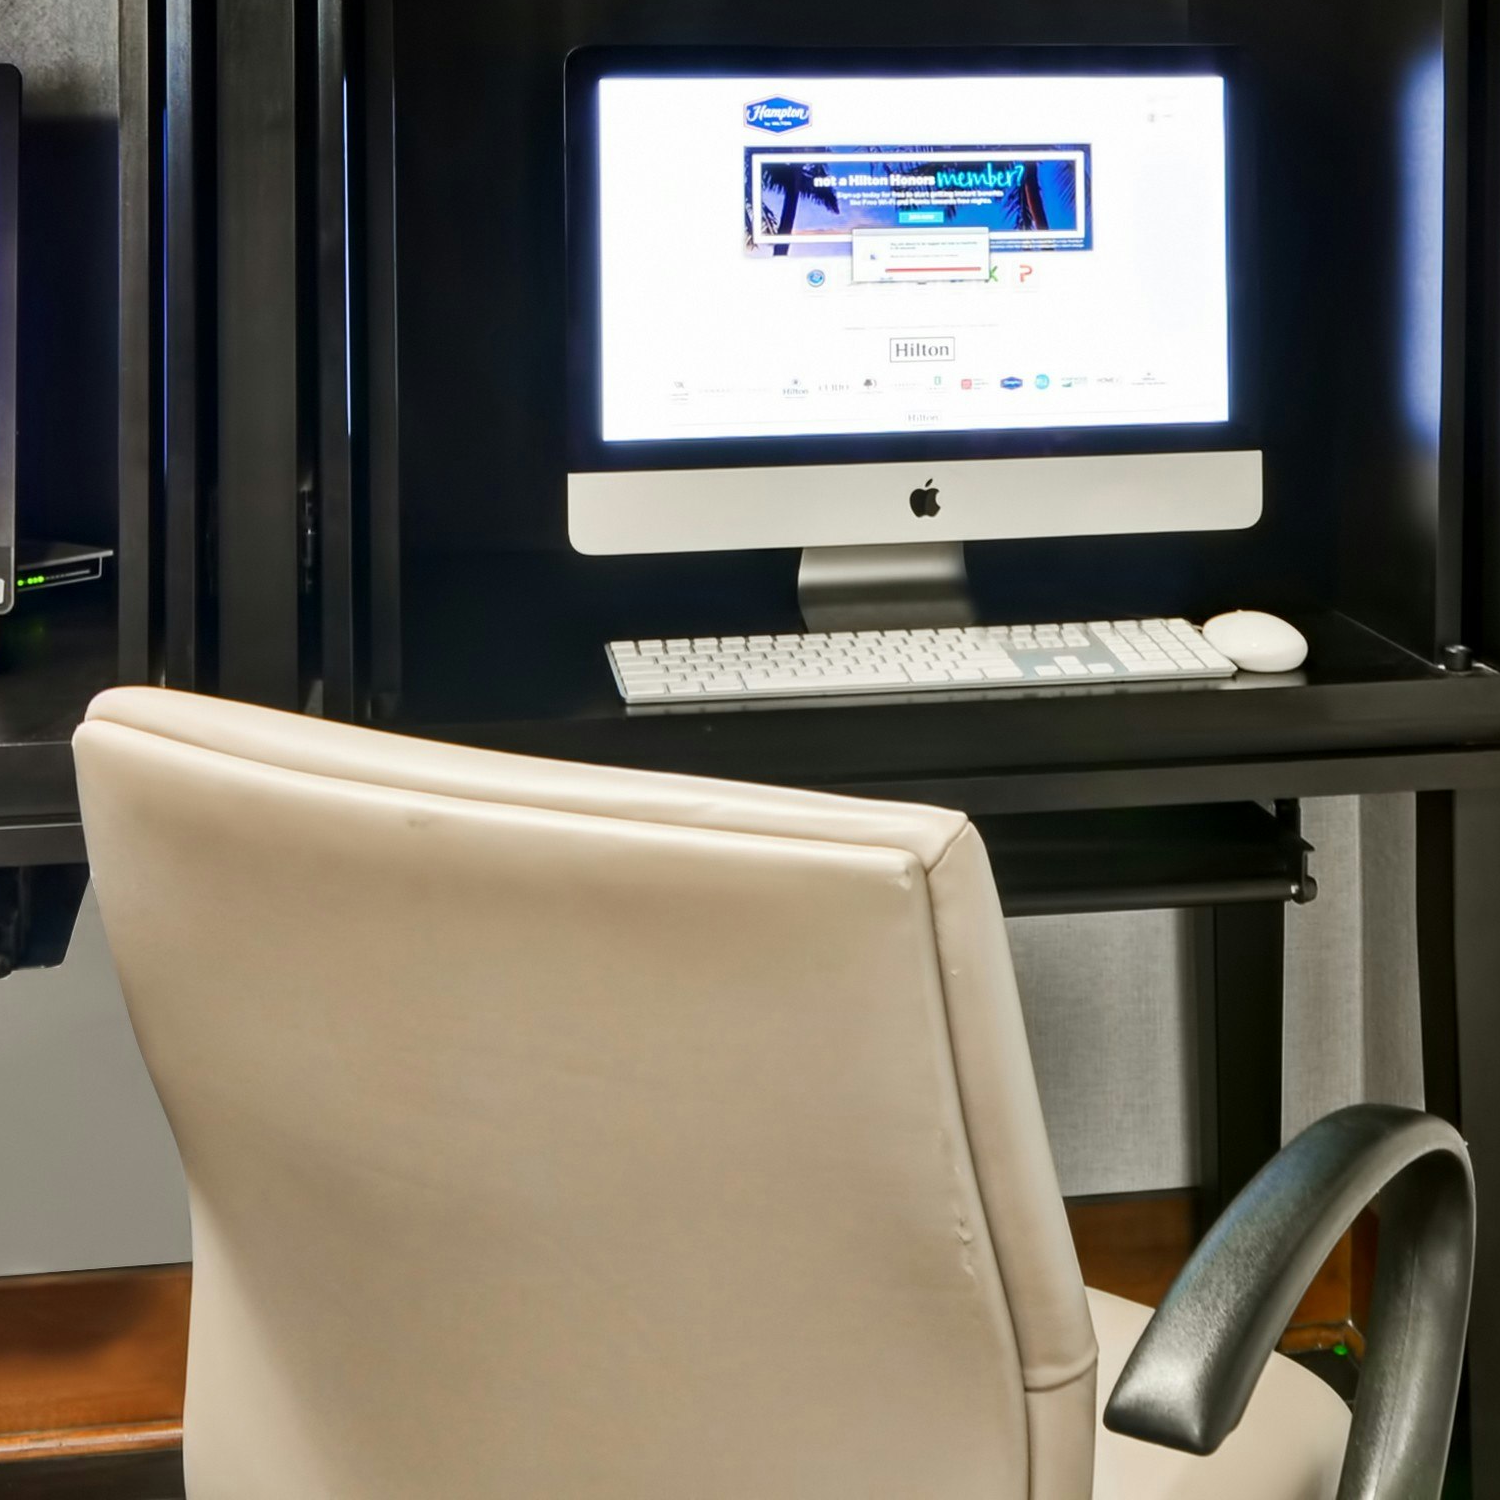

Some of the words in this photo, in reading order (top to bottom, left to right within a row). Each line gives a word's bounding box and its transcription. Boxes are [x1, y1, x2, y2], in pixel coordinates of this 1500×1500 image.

[746, 104, 809, 122] Hampton
[814, 176, 837, 187] not
[839, 177, 849, 187] a
[851, 175, 888, 187] Hilton
[890, 174, 935, 187] Honors
[936, 162, 1025, 188] member?
[895, 343, 950, 358] Hilton
